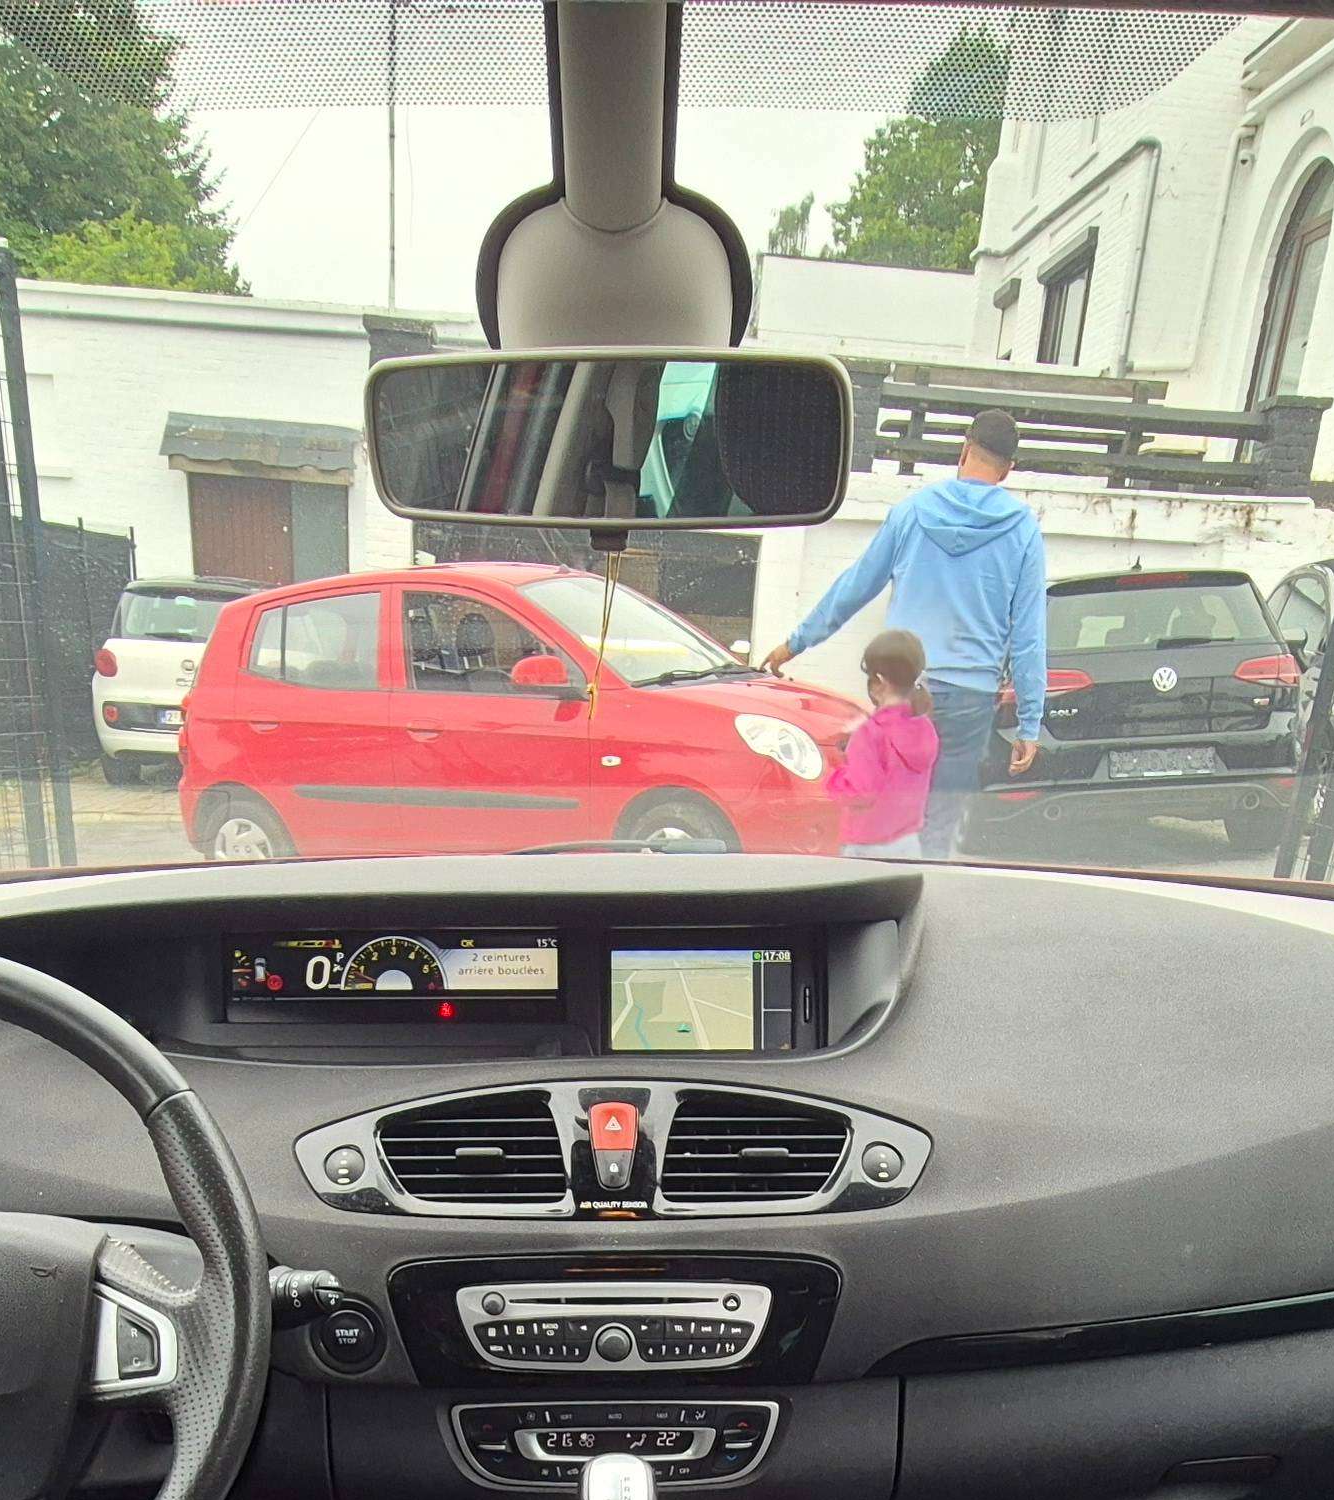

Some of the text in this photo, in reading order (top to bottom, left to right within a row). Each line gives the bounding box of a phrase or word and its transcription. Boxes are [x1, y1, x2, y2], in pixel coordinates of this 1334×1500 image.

[1049, 708, 1079, 717] GOLF
[390, 947, 397, 956] 3
[408, 951, 416, 960] 4
[336, 952, 345, 962] P
[372, 952, 379, 961] 2
[472, 953, 531, 962] 2 ceintures
[306, 955, 331, 990] 0
[422, 965, 430, 974] 5
[498, 966, 545, 976] bouclées
[592, 1201, 621, 1209] QUALITY
[622, 1201, 648, 1209] SENSOR
[130, 1328, 138, 1338] R
[335, 1329, 360, 1337] START
